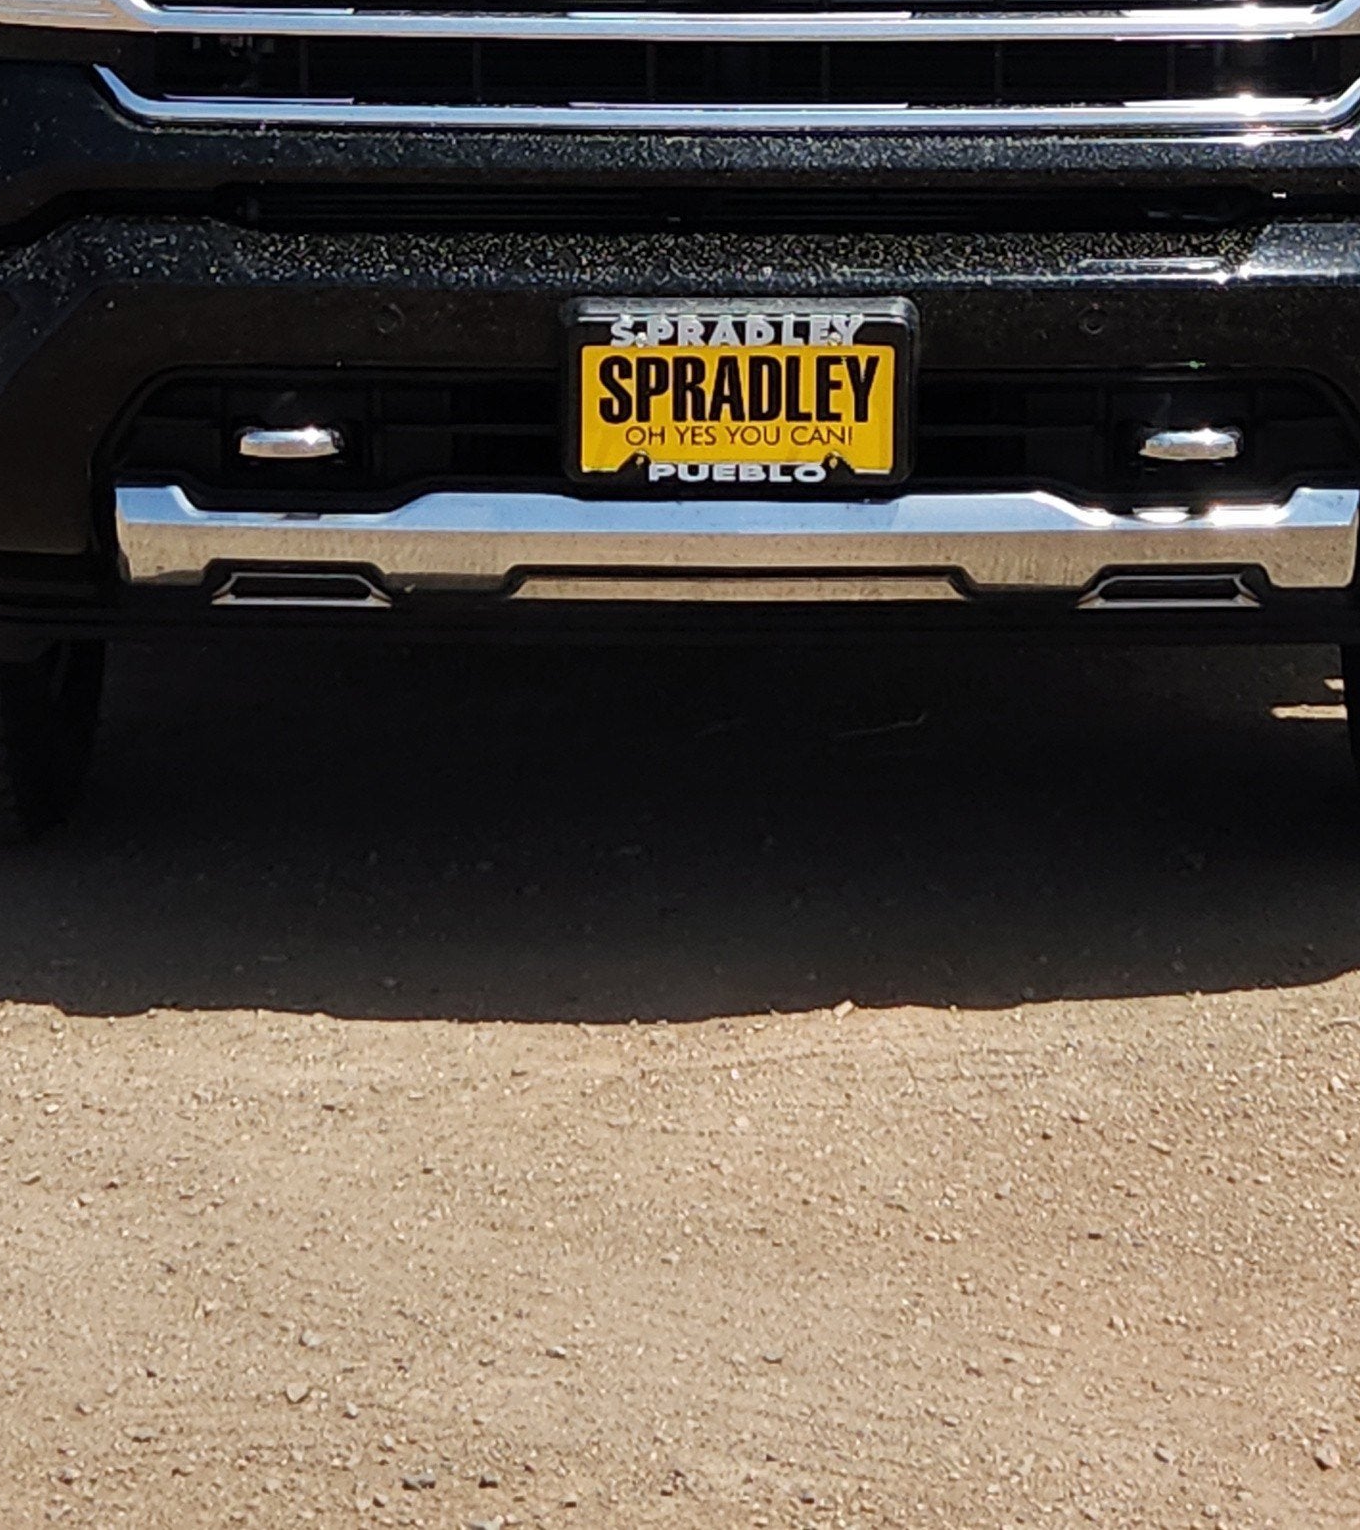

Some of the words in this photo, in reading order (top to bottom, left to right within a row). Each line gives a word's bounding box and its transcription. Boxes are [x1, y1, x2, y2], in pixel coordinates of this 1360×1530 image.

[610, 314, 864, 347] SPRADLEY
[598, 354, 880, 424] SPRADLEY
[624, 425, 666, 447] OH
[674, 425, 718, 446] YES
[725, 425, 781, 447] YOU
[790, 425, 854, 447] CAN!
[647, 463, 828, 483] PUEBLO
